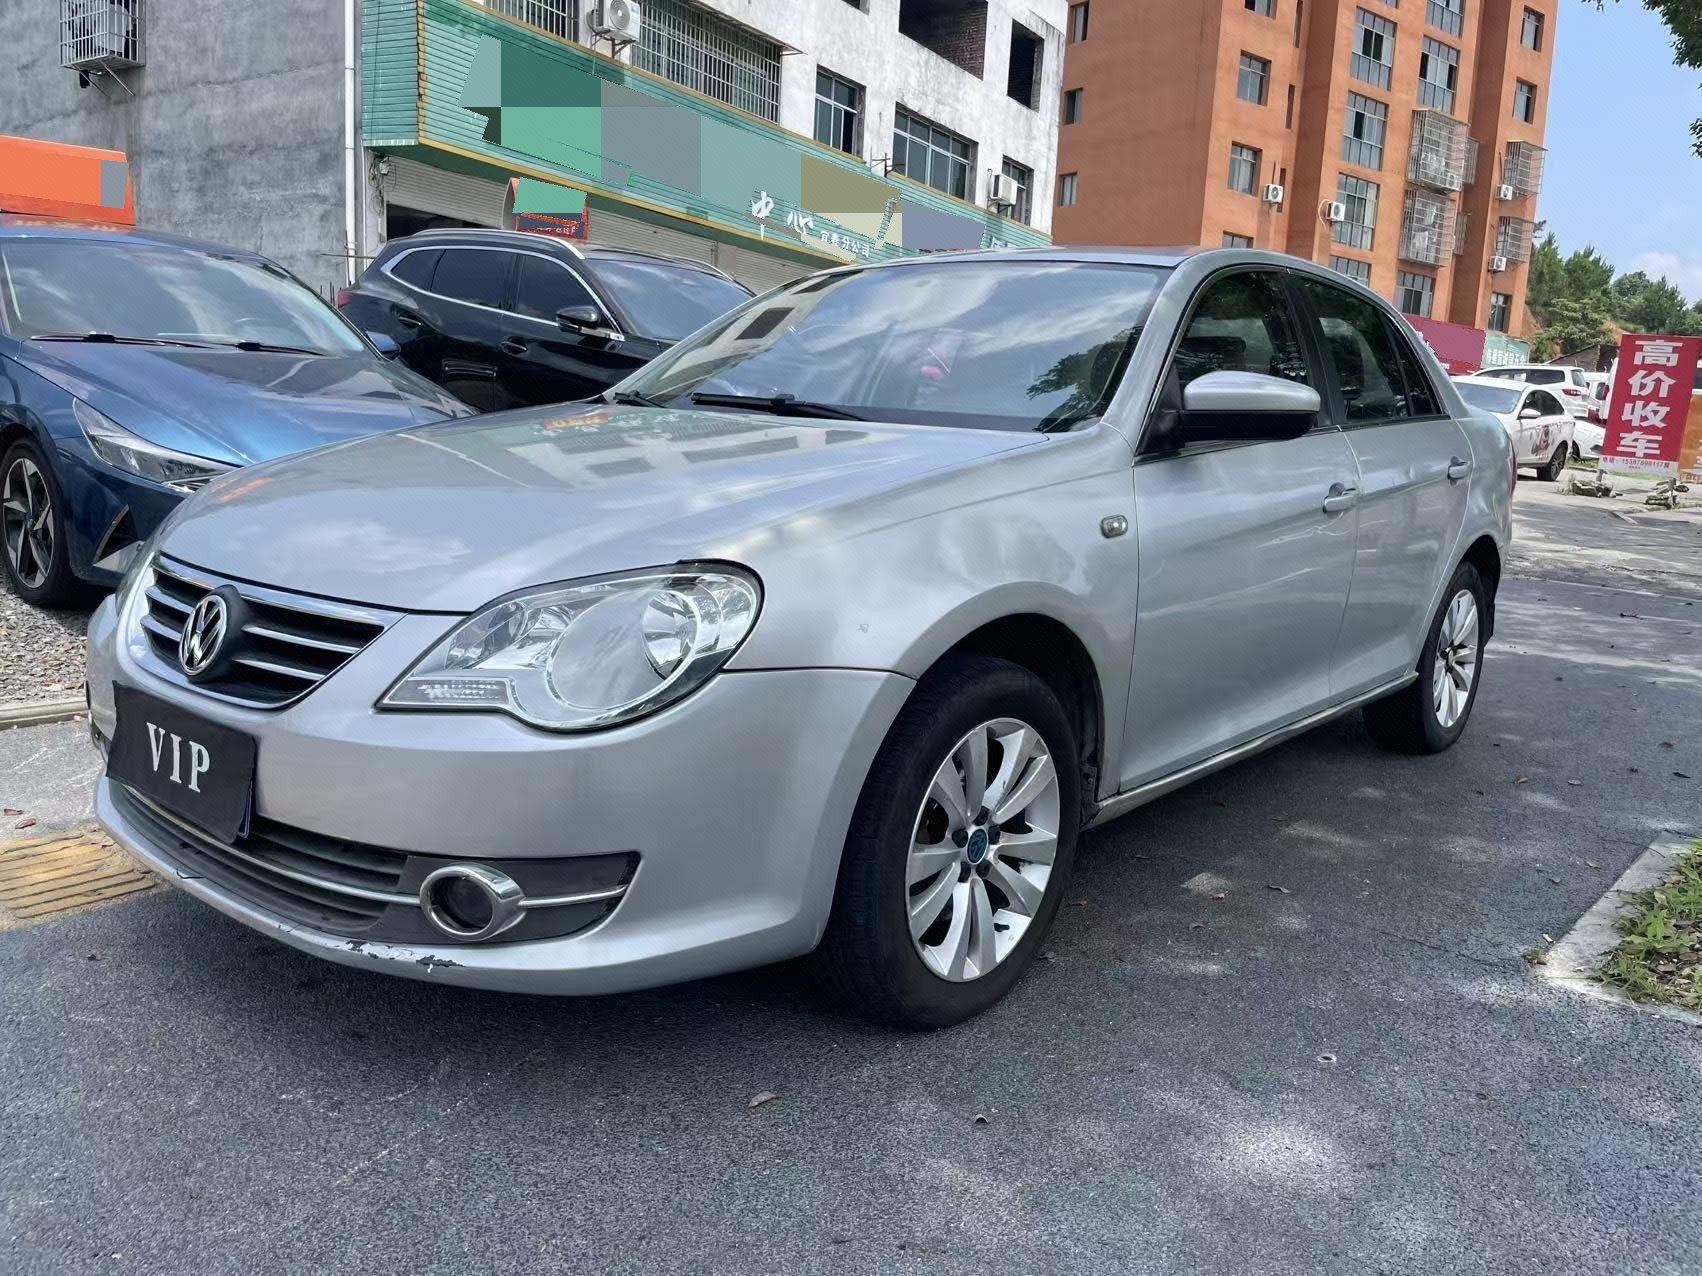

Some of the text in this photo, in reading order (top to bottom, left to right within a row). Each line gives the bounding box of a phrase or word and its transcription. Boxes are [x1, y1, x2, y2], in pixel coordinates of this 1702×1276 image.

[819, 230, 871, 258] 宜春分公司
[1616, 339, 1684, 458] 高价收车
[146, 722, 211, 793] VIP
